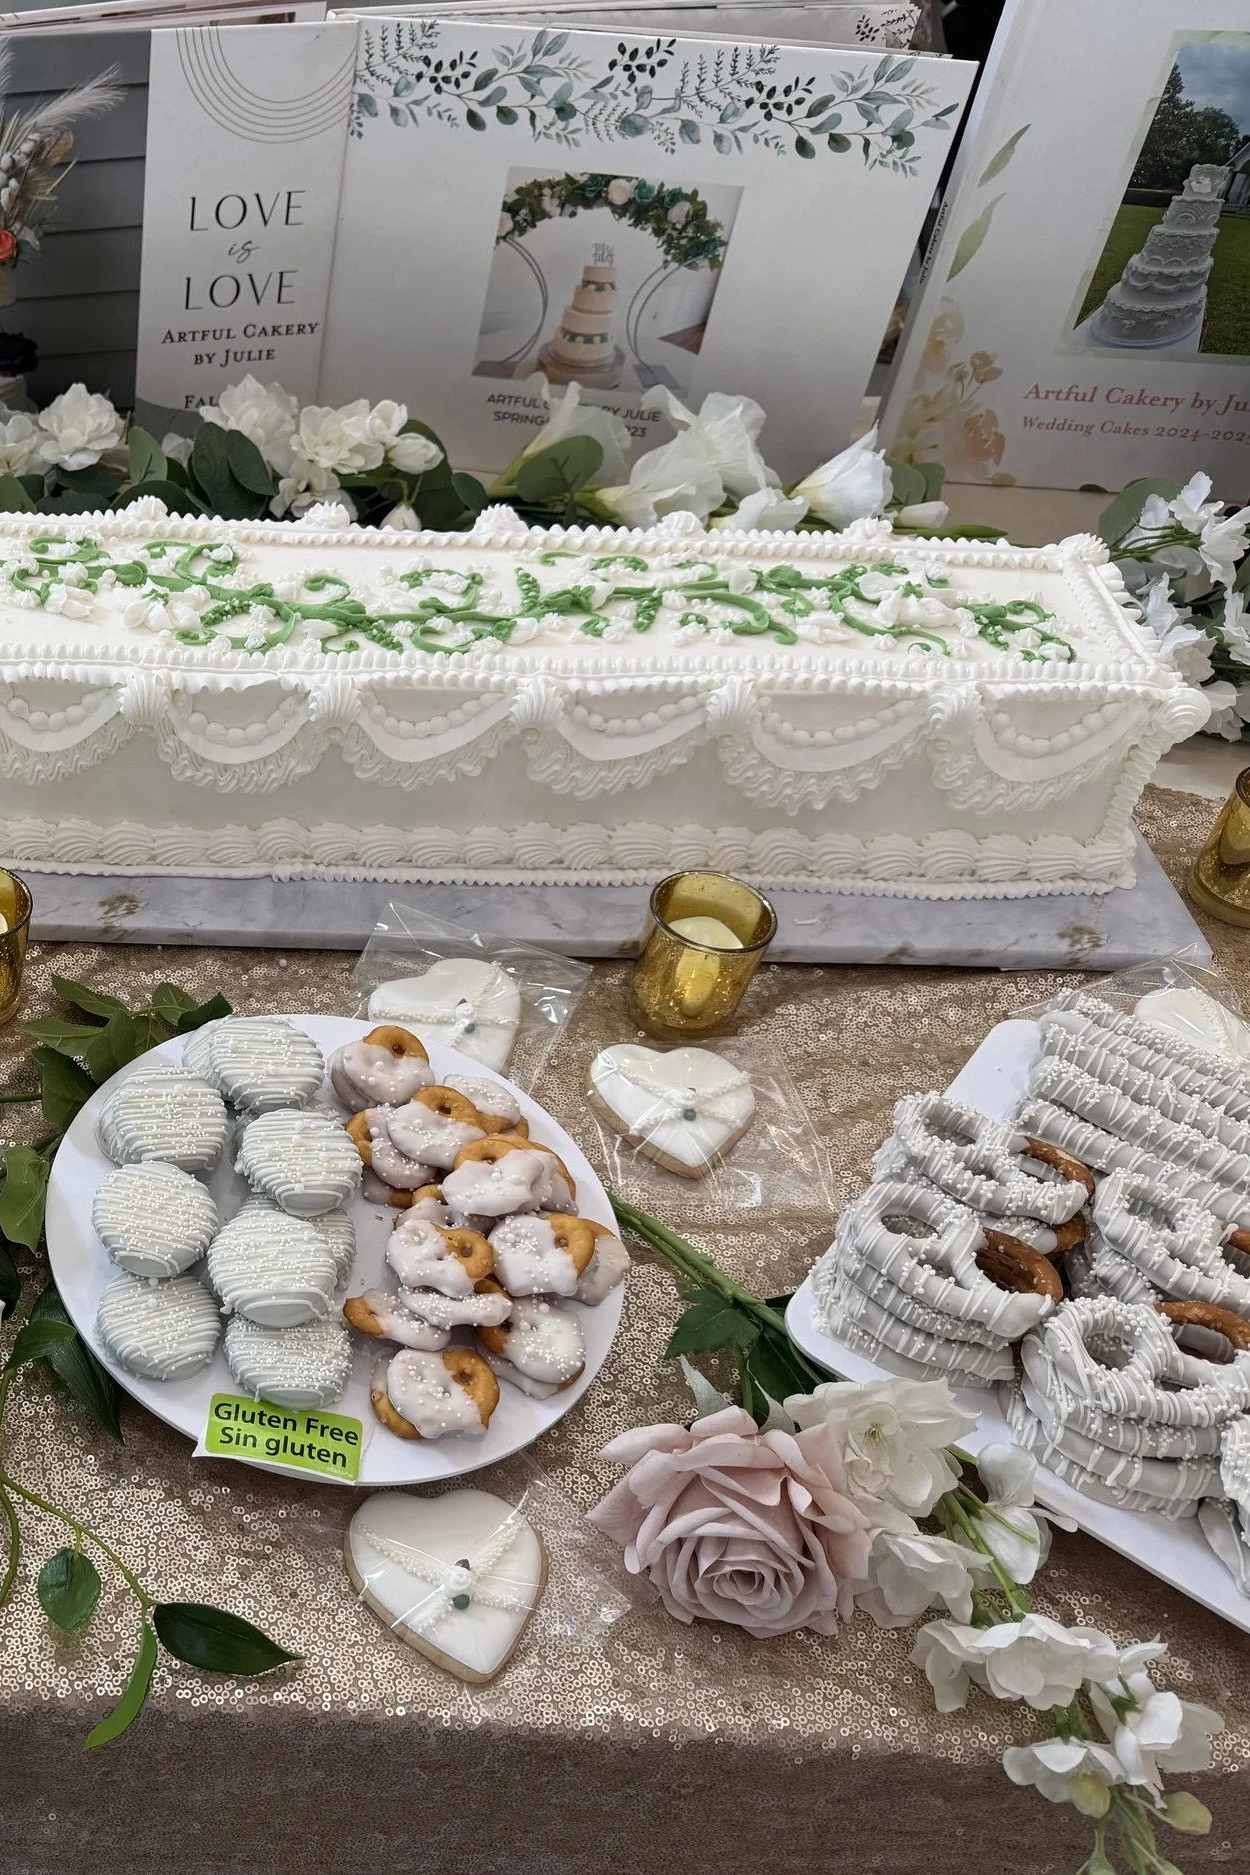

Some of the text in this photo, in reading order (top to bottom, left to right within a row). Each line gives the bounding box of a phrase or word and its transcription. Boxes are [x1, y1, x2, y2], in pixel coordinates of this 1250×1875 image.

[190, 190, 306, 231] LOVE
[227, 240, 261, 264] is
[184, 270, 298, 311] LOVE
[486, 394, 543, 409] ARTFUL
[622, 409, 661, 422] JULIE
[1023, 383, 1098, 403] Artful
[1105, 386, 1185, 413] Cakery
[1190, 392, 1217, 416] by
[1023, 416, 1096, 436] Wedding
[1100, 420, 1150, 436] Cakes
[214, 1402, 359, 1446] Gluten Free
[219, 1426, 347, 1468] Sin gluten
